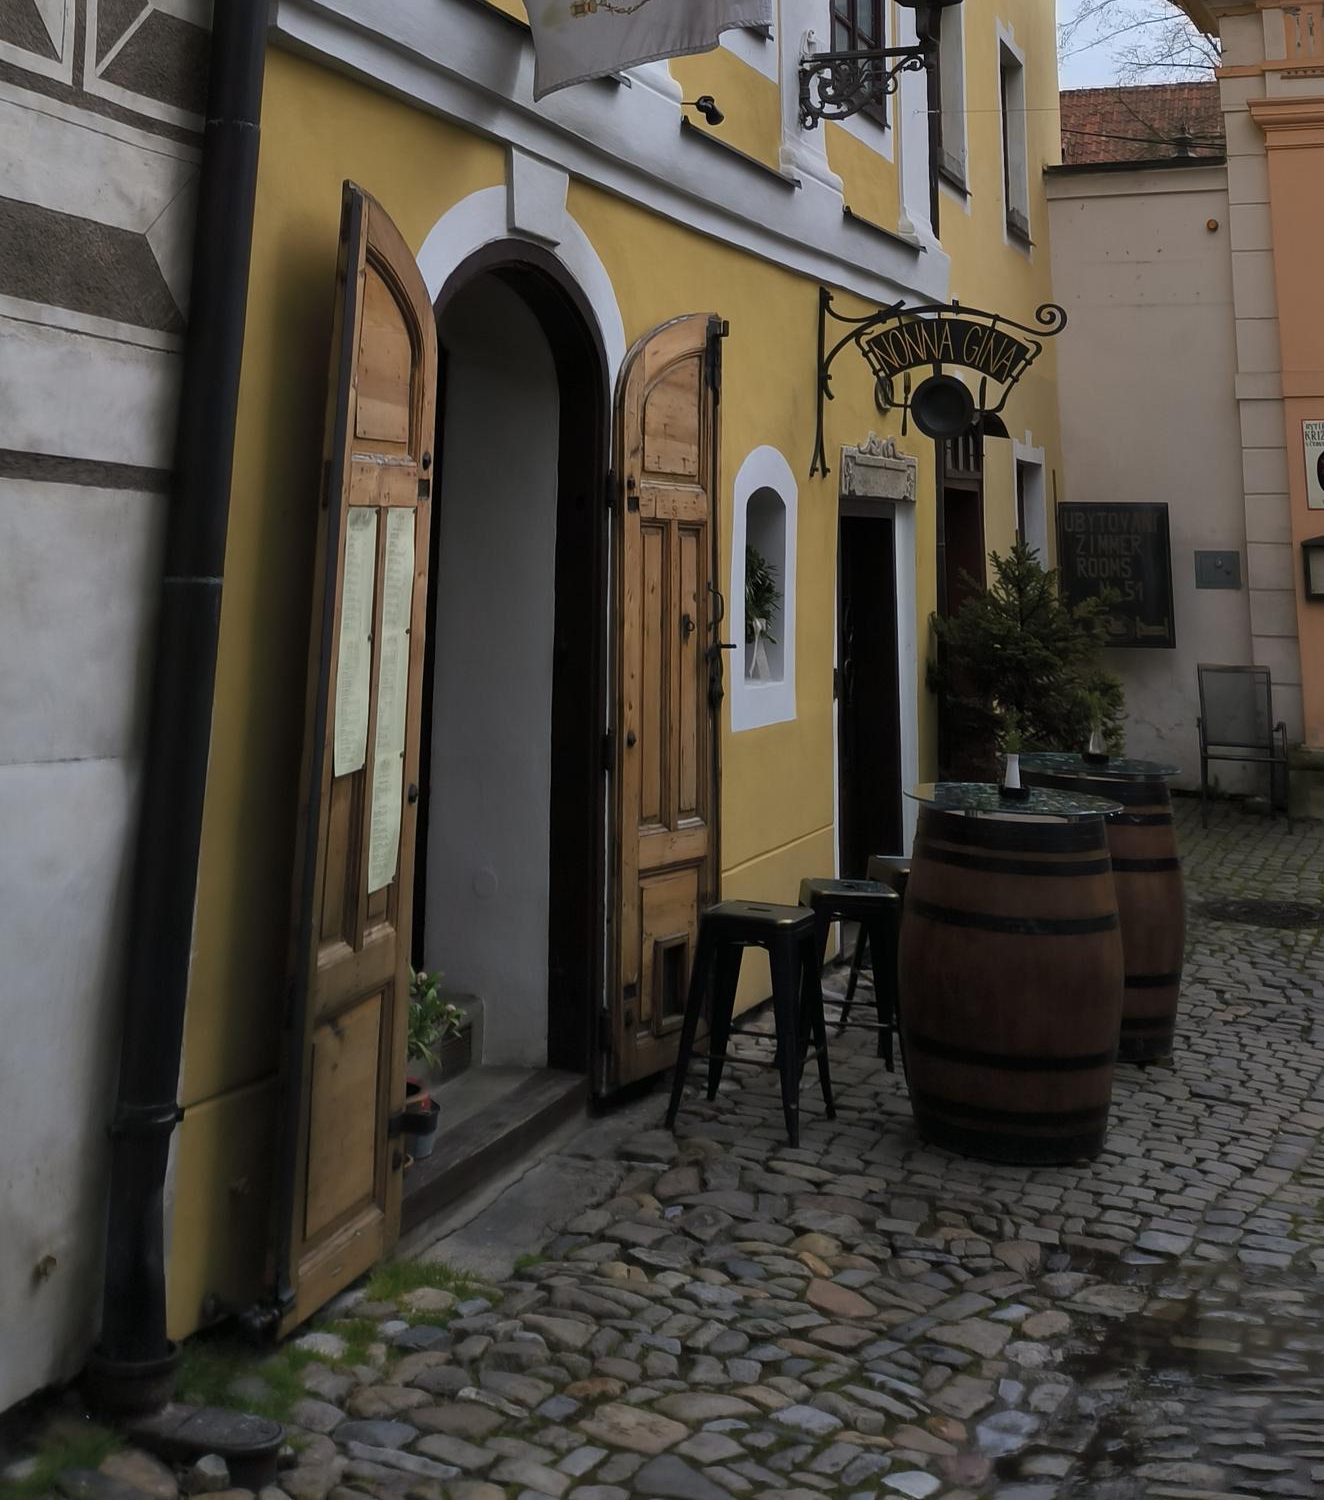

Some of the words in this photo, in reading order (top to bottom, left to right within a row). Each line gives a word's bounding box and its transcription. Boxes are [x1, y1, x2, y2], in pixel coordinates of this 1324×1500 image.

[870, 321, 954, 375] NONNA
[963, 325, 1018, 381] GINA
[1075, 534, 1144, 556] ZIMMER
[1076, 557, 1133, 579] ROOMS
